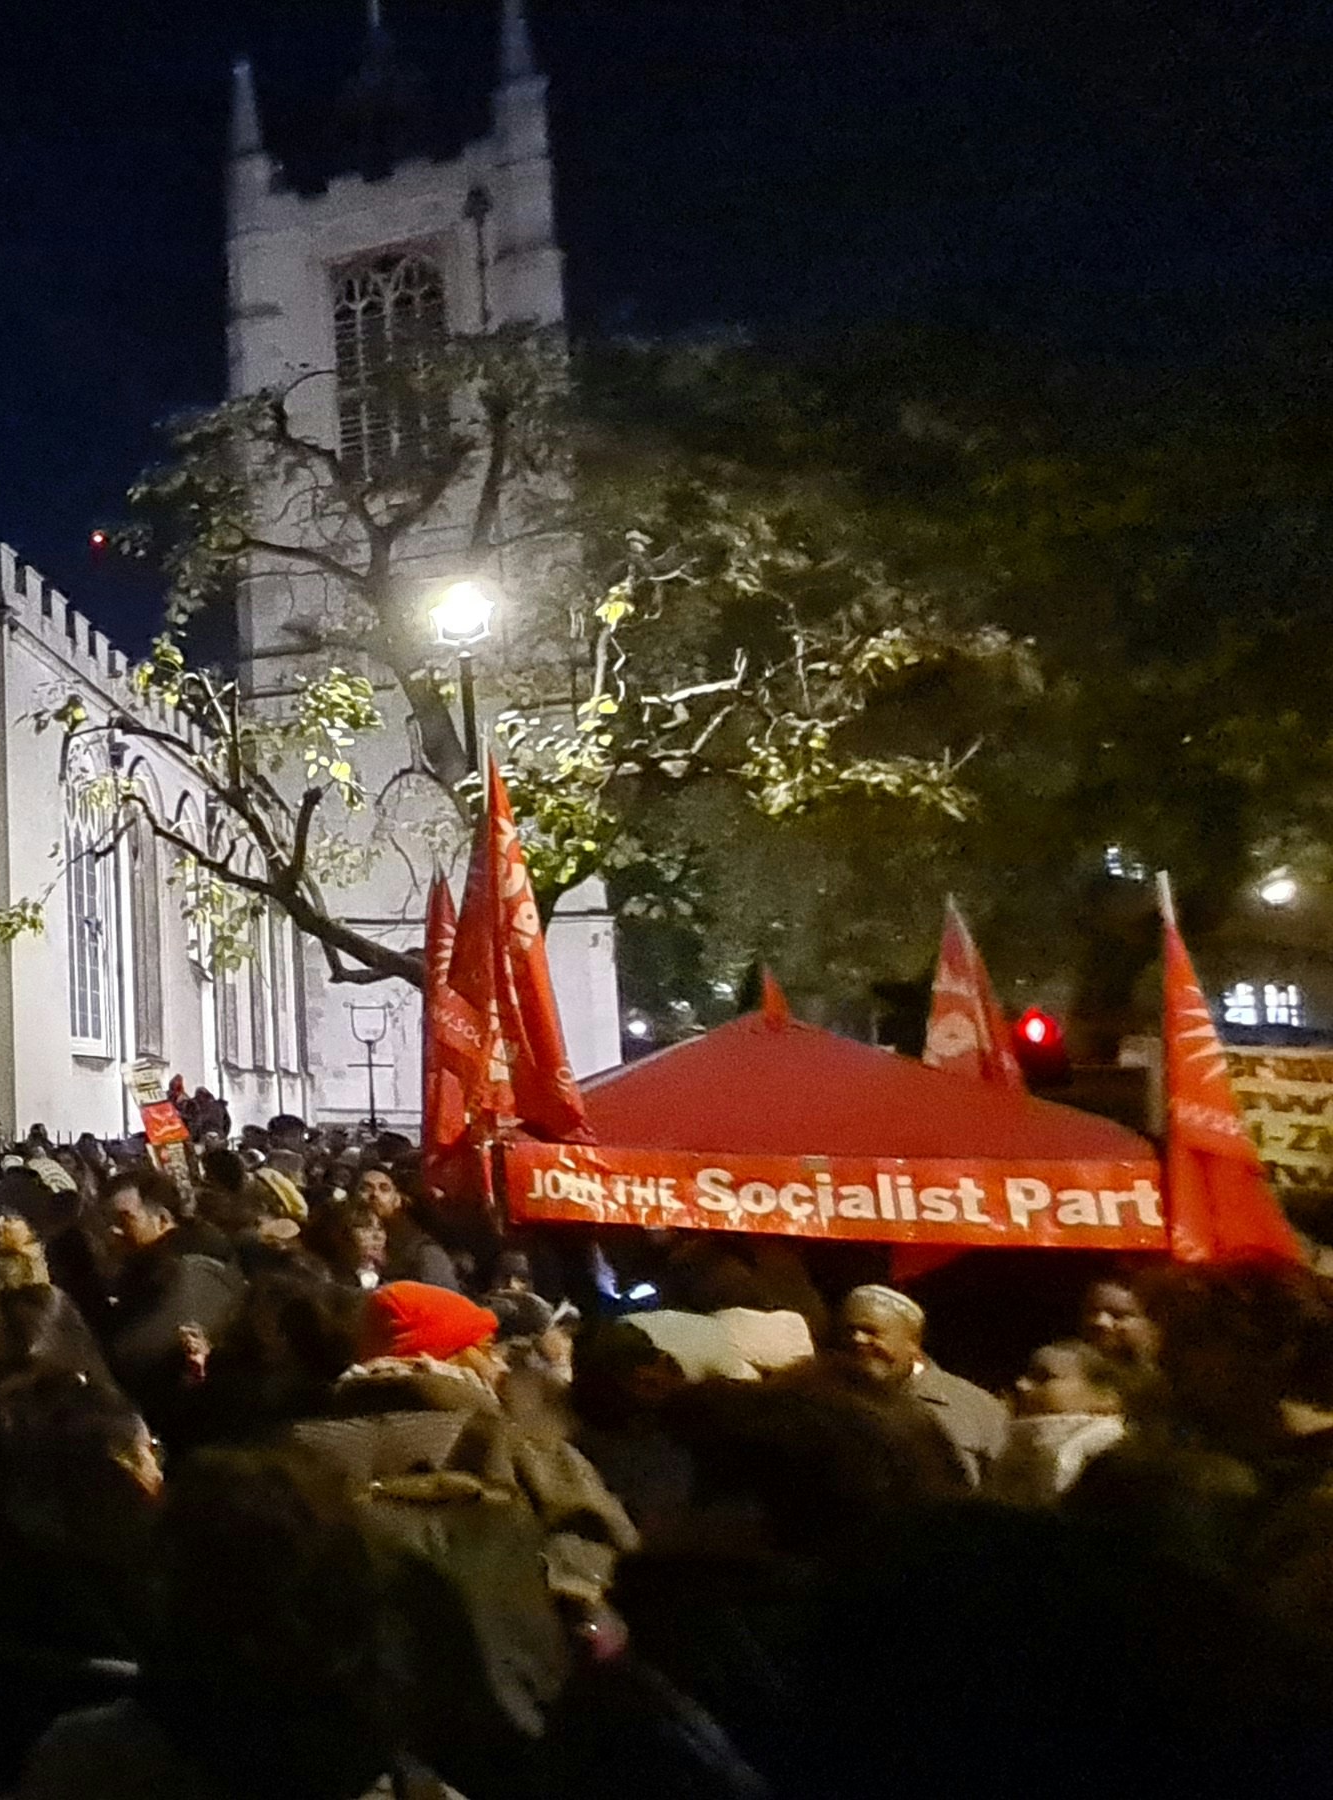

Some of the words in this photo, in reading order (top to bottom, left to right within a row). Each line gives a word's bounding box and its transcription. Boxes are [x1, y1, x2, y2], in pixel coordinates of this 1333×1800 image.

[528, 1168, 604, 1203] JOIN
[609, 1174, 680, 1208] THE
[696, 1167, 991, 1224] Socialist
[1004, 1177, 1164, 1228] Part
